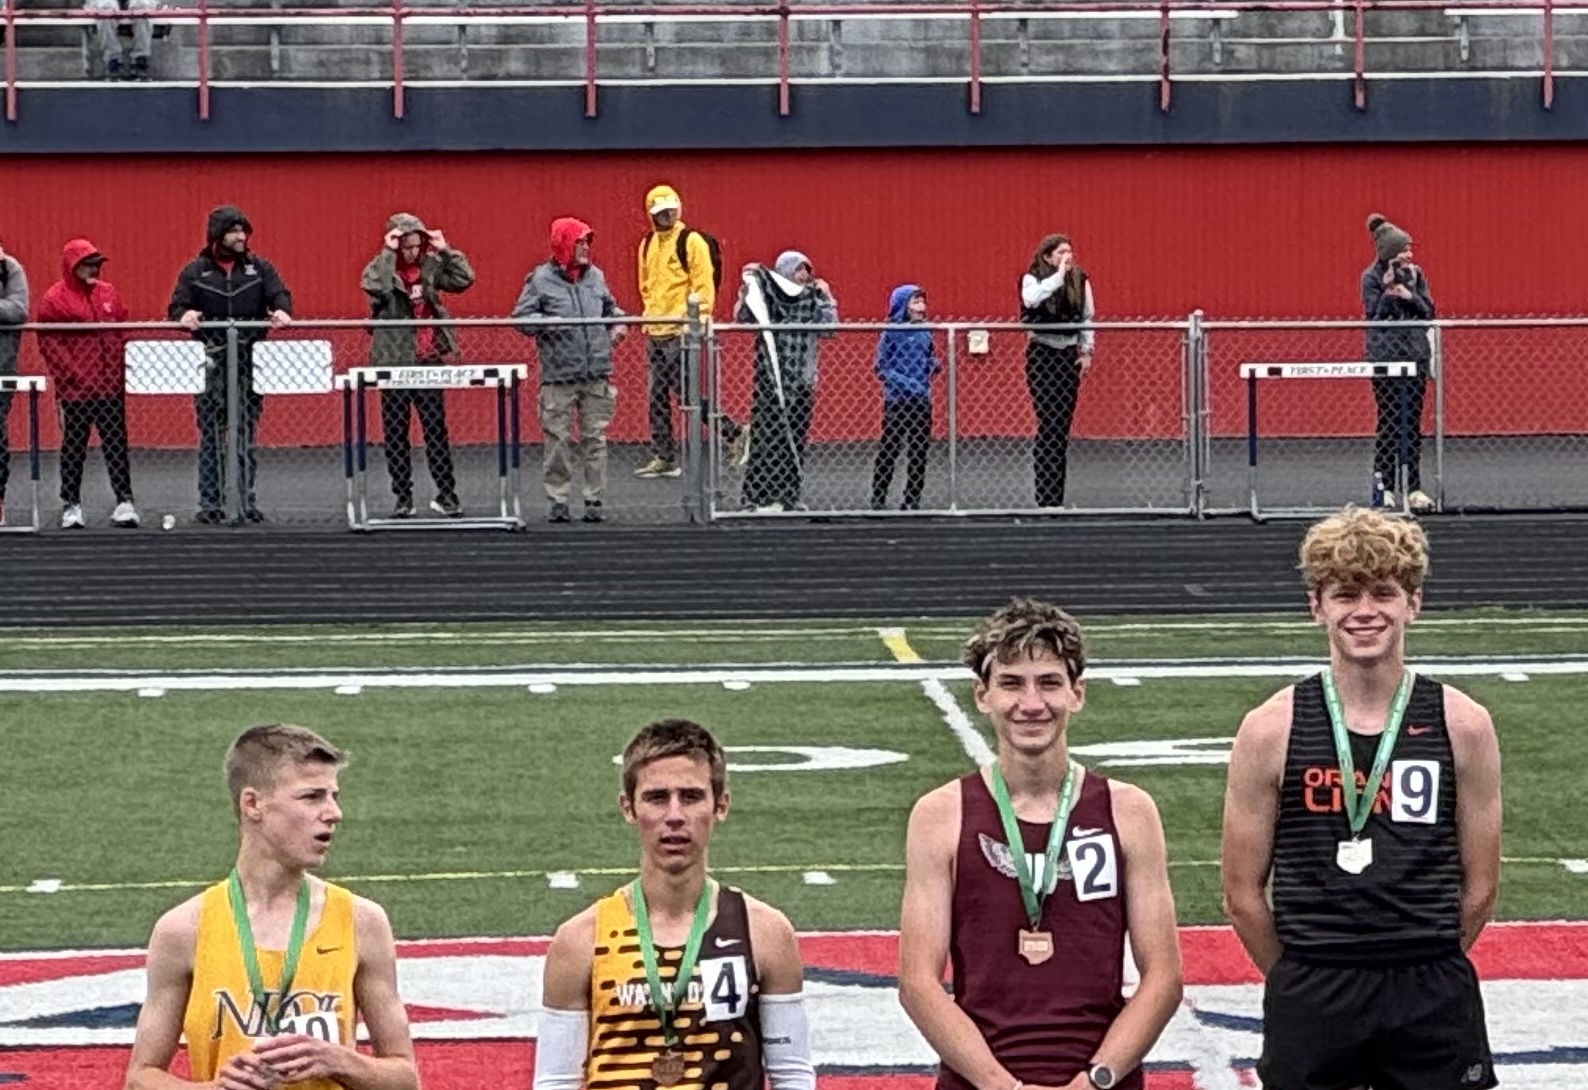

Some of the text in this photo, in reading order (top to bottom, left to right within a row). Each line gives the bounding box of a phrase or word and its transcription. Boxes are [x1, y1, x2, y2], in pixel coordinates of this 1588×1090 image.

[1400, 765, 1433, 818] 9
[1075, 841, 1111, 895] 2
[710, 961, 742, 1014] 4
